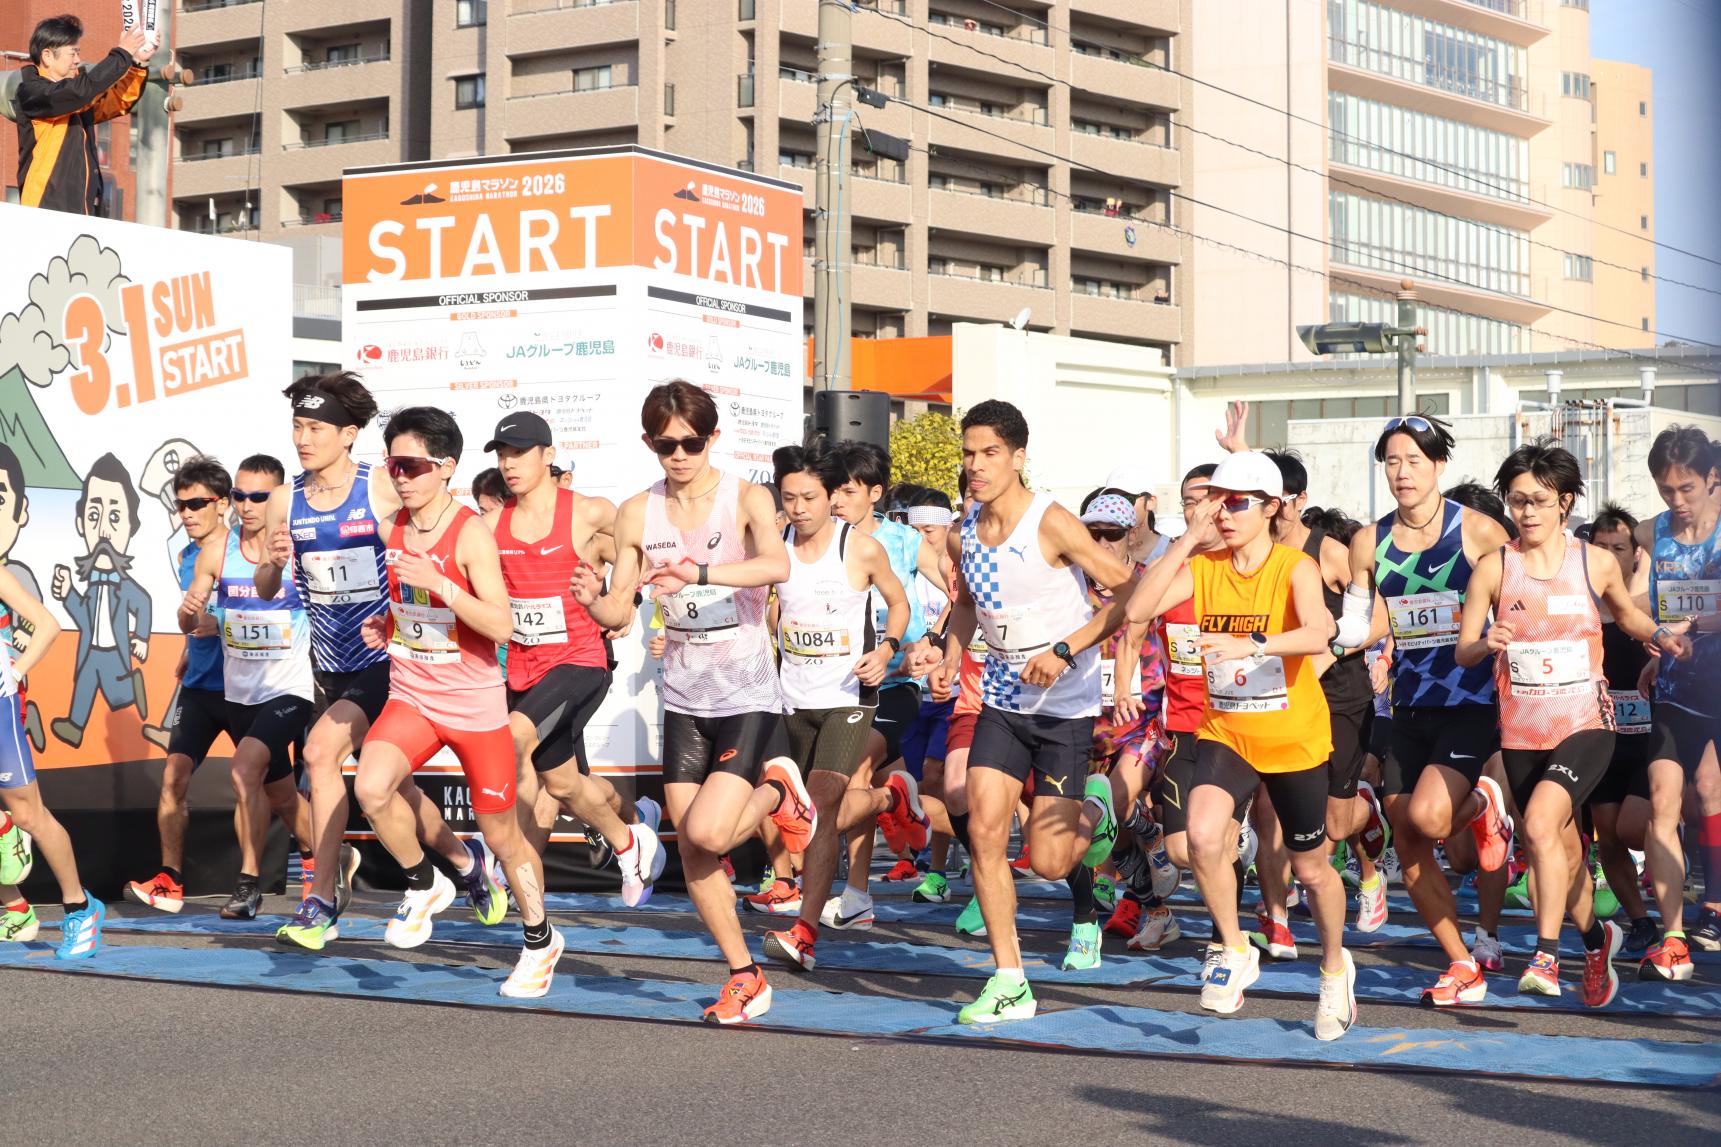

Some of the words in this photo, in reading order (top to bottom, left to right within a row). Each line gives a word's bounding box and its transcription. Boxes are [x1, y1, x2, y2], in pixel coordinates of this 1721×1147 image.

[450, 178, 519, 193] 鹿児島マラソン
[522, 173, 565, 196] 2026
[741, 193, 765, 216] 2026
[366, 204, 611, 282] START
[653, 208, 789, 293] START
[152, 271, 215, 337] SUN
[438, 294, 480, 306] OFFICIAL
[482, 290, 529, 304] SPONSOR
[696, 296, 720, 309] OFFICIAL
[721, 300, 746, 313] SPONSOR
[65, 284, 156, 415] 3.1
[387, 346, 448, 363] 鹿児島銀行
[506, 340, 615, 359] JAグループ鹿児島
[162, 335, 242, 389] START
[734, 356, 791, 377] JAグループ鹿児島
[645, 541, 677, 551] WASEDA
[328, 565, 347, 582] 11
[228, 586, 286, 599] 国分自隊
[662, 605, 670, 616] S
[686, 602, 698, 619] 8
[1660, 600, 1668, 611] S
[1677, 596, 1704, 611] 110
[515, 612, 544, 626] 142
[1202, 616, 1227, 632] FLY
[1229, 616, 1267, 632] HIGH
[1391, 617, 1398, 627] S
[1408, 608, 1438, 627] 161
[226, 627, 232, 637] S
[242, 625, 269, 640] 151
[413, 622, 423, 639] 9
[794, 631, 835, 647] 1084
[996, 625, 1008, 641] 7
[1170, 641, 1178, 653] S
[1510, 661, 1519, 674] S
[1542, 658, 1553, 675] 5
[1207, 671, 1215, 684] S
[1234, 668, 1247, 687] 6
[1612, 703, 1637, 717] 12
[1548, 764, 1579, 782] 2XU
[1294, 824, 1325, 841] 2XU
